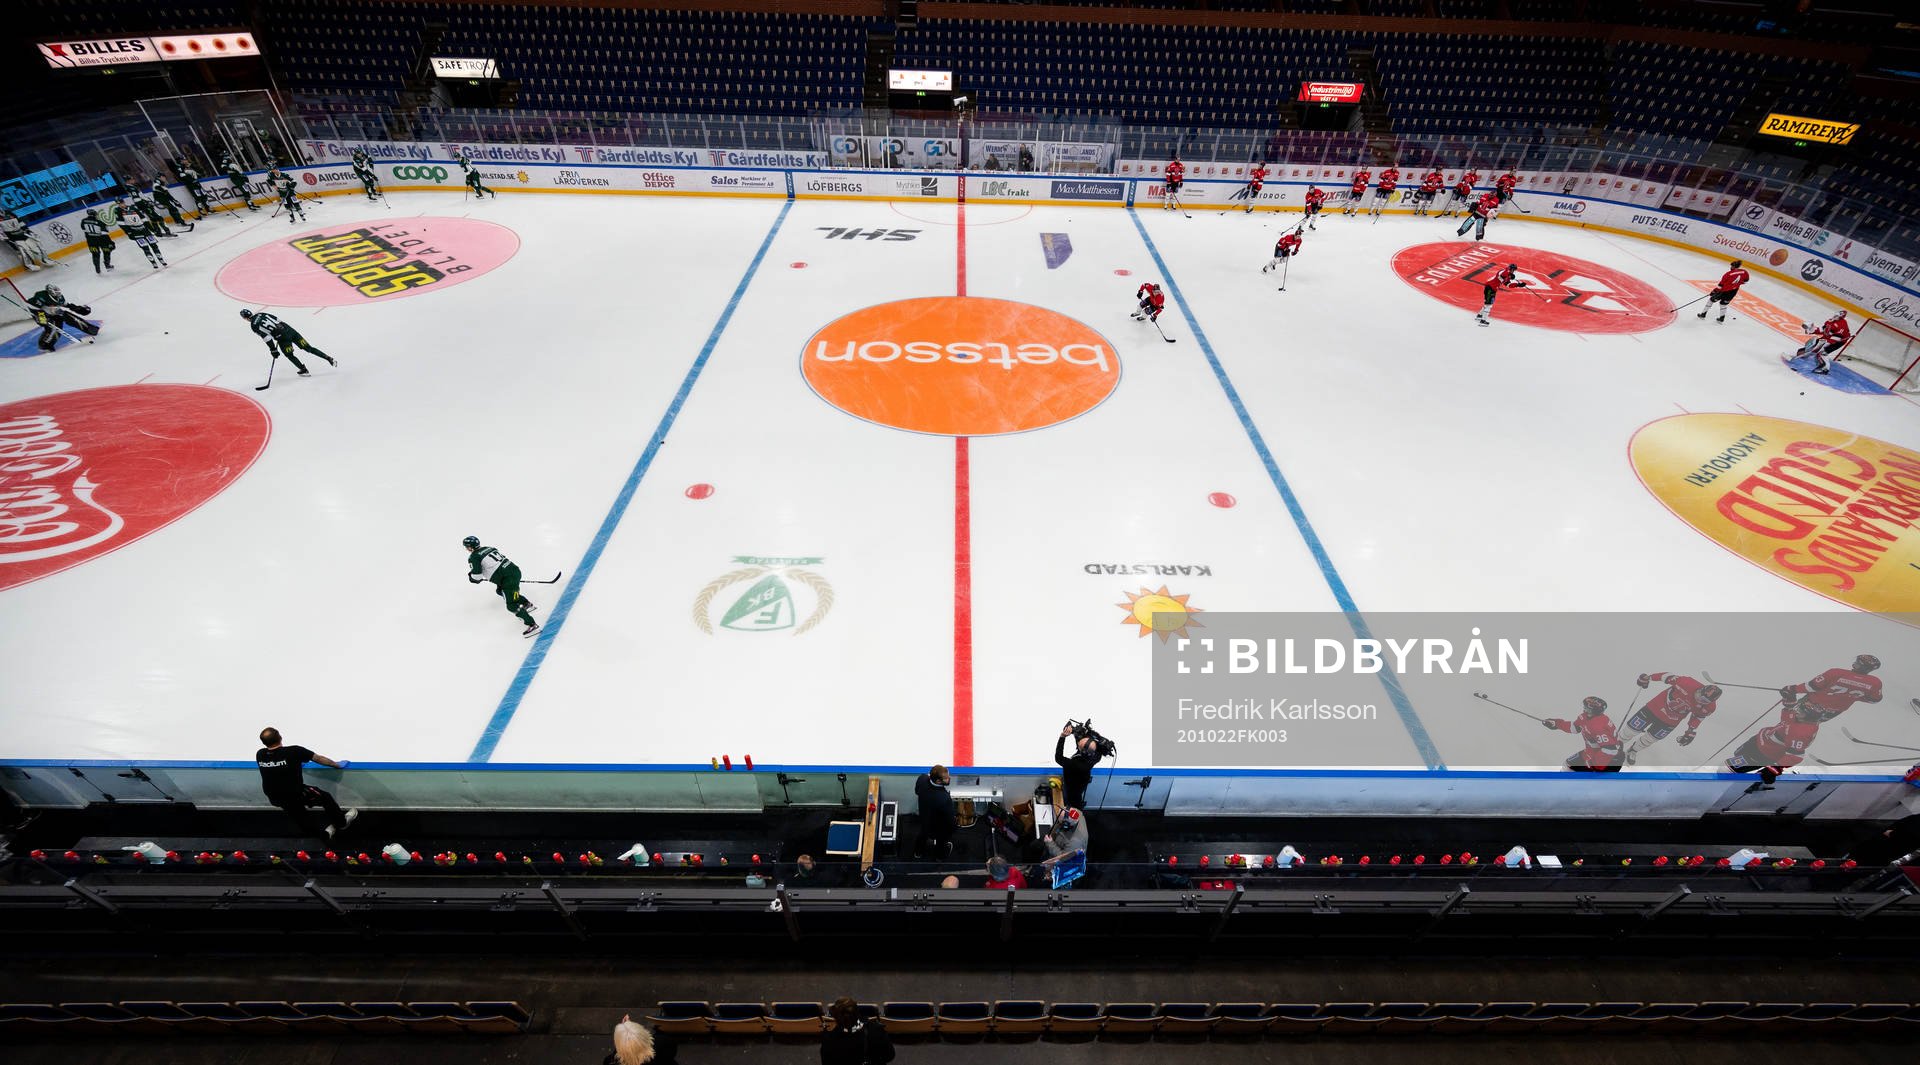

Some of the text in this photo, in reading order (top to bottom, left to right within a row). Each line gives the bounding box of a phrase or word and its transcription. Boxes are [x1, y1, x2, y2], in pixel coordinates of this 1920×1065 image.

[69, 39, 146, 55] BILLES
[79, 57, 100, 65] Billes
[101, 55, 129, 64] Tryckeri
[438, 60, 462, 69] SAFE
[1310, 86, 1353, 95] Industrimiljö
[1766, 118, 1851, 141] RAMIRENT
[407, 145, 433, 161] Kyl
[461, 146, 567, 163] Gårdfeldts Kyl
[597, 149, 699, 166] Gårdfeldts Kyl
[728, 152, 829, 168] Gårdfeldts Kyl
[318, 172, 359, 182] AllOffic
[393, 165, 448, 184] coop
[478, 173, 516, 181] ARLSTAD.SE
[554, 176, 609, 187] LÄROVERKEN
[642, 172, 675, 182] Office
[807, 181, 862, 193] LÖFBERGS
[1008, 188, 1030, 197] frakt
[1056, 183, 1120, 195] Max Matthiessen
[1554, 201, 1579, 211] KMAB
[1632, 214, 1689, 234] PUTS TEGEL
[815, 226, 924, 242] SHL
[370, 223, 473, 275] BLADET
[1713, 234, 1770, 259] Swedbank
[287, 227, 447, 298] SPORT
[1414, 245, 1501, 285] BAUHAUS
[1802, 262, 1823, 276] ISS
[815, 340, 1110, 372] betsson
[1684, 432, 1767, 488] ALKOHOLFRI
[1716, 441, 1877, 541] GULD
[1083, 563, 1213, 577] KARLSTAD
[1596, 734, 1610, 744] 36
[1791, 739, 1804, 750] 18
